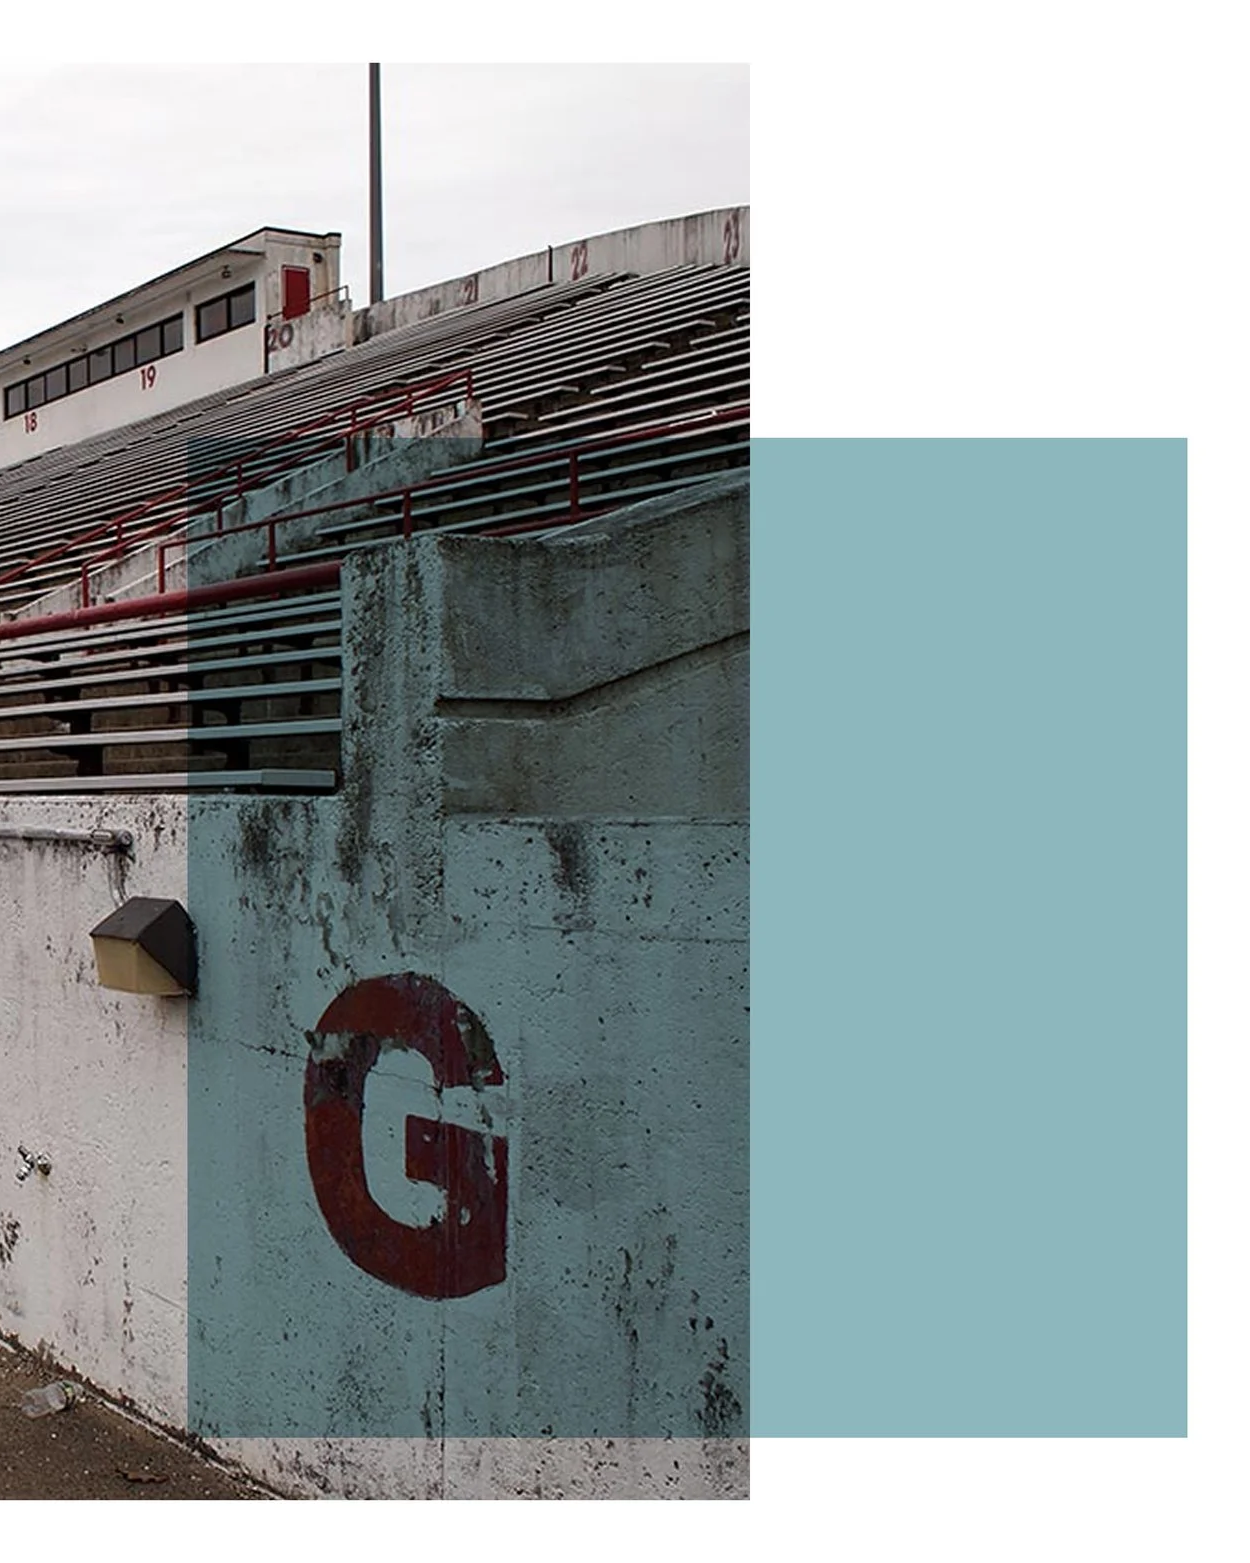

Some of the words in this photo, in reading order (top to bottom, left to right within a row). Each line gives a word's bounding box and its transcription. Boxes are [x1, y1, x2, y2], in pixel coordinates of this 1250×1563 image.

[570, 240, 588, 280] 22
[268, 323, 294, 352] 20
[140, 365, 156, 390] 19
[24, 412, 38, 433] 18
[303, 971, 510, 1301] G
